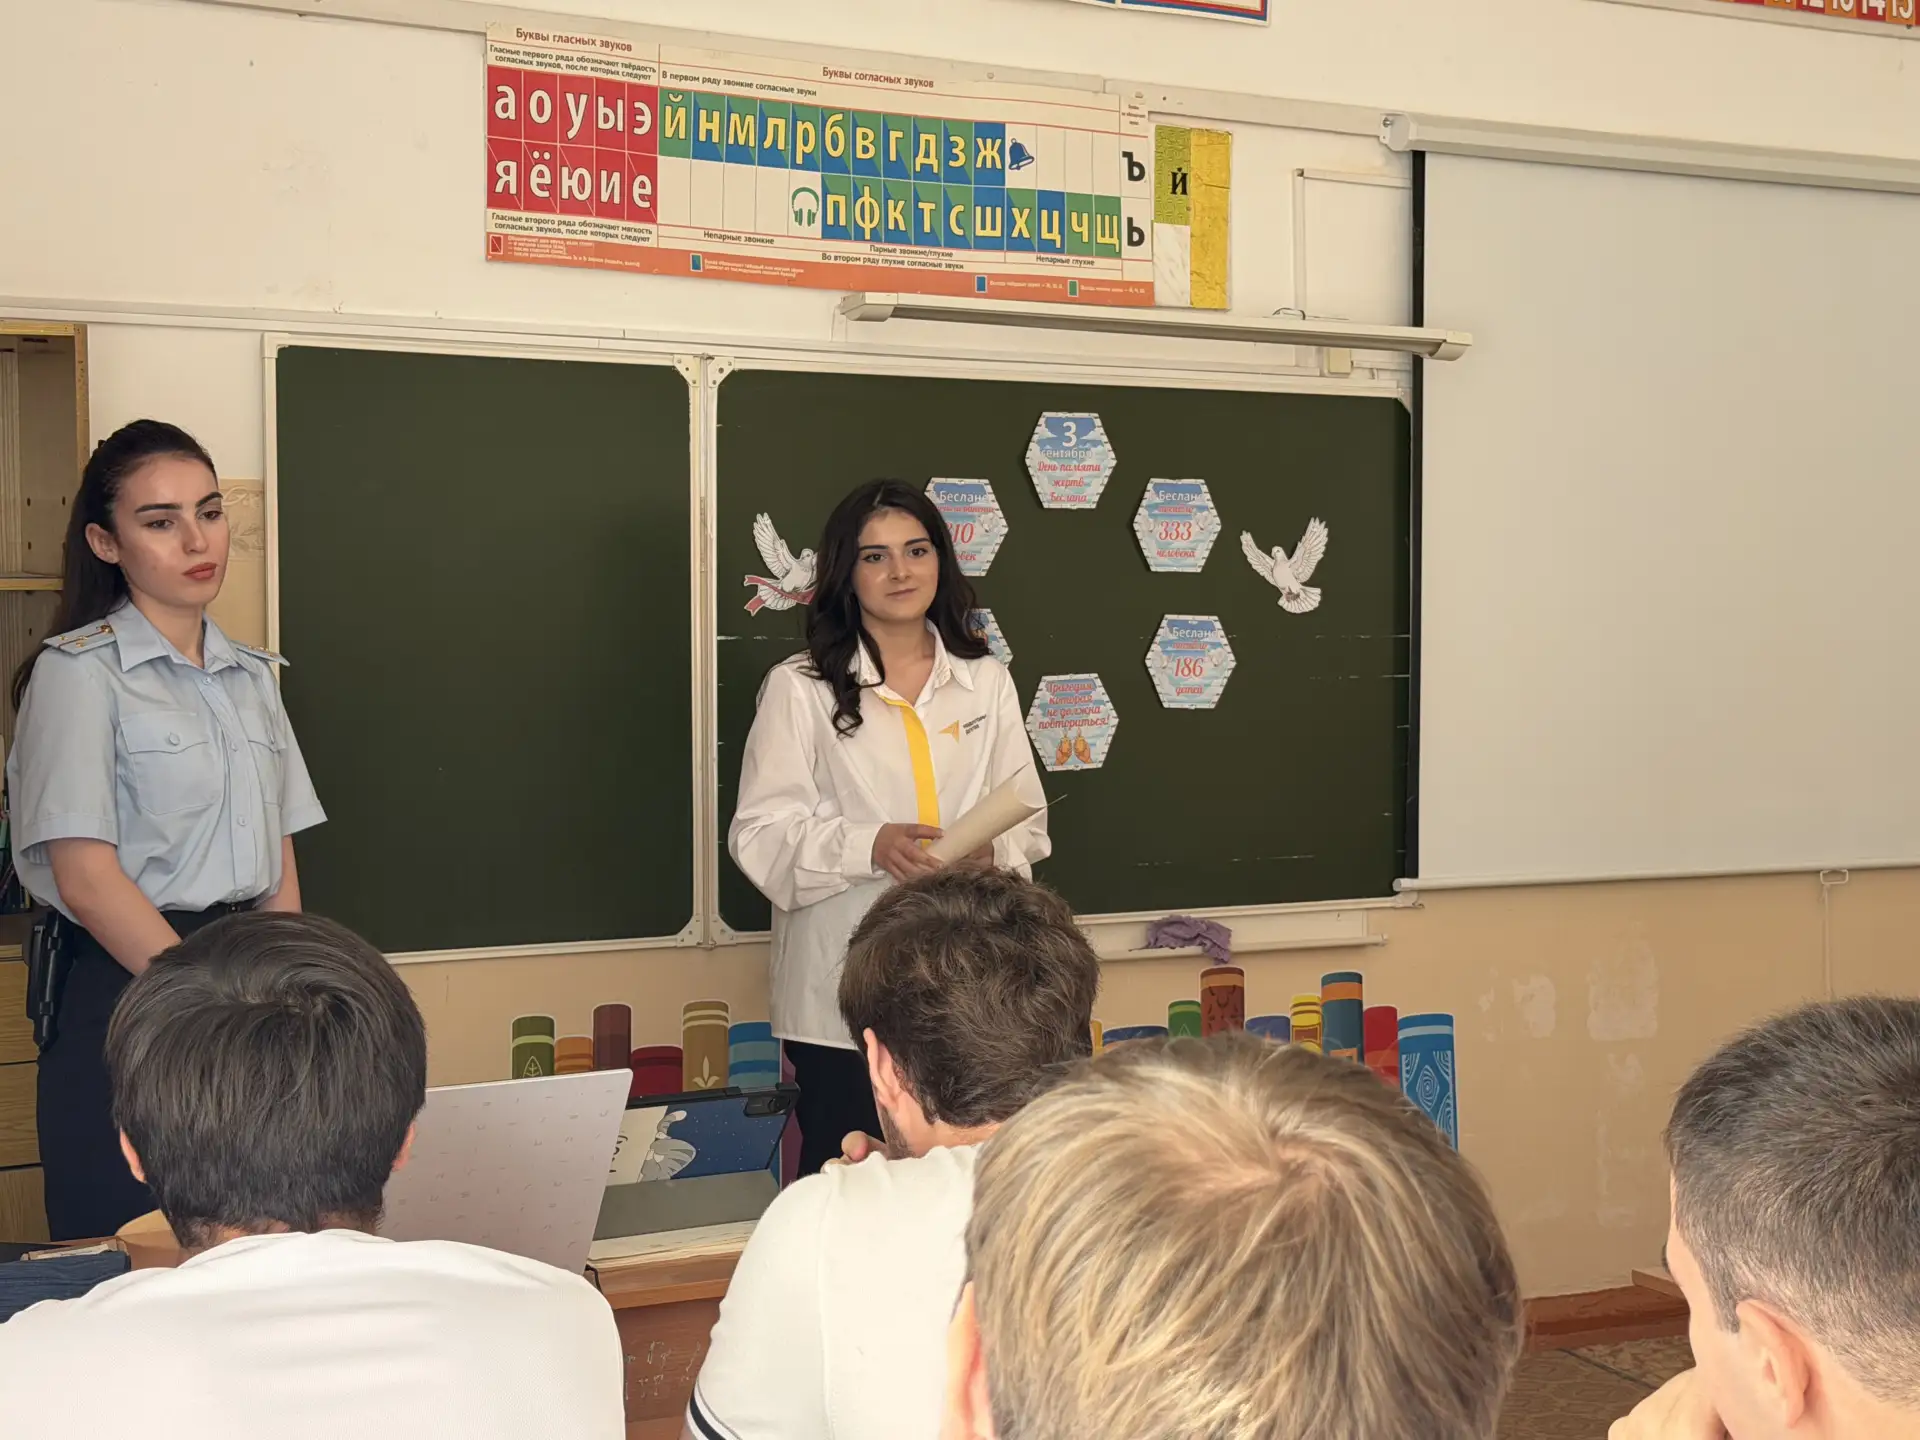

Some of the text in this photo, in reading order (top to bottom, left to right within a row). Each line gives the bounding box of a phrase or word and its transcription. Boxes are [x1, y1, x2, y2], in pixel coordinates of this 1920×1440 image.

[516, 27, 633, 52] Буквы гласных звуков
[490, 44, 657, 73] Гласные первого ряда обозначают твёрдость
[495, 55, 652, 81] согласных звуков, после которых следуют
[661, 70, 817, 97] В первом ряду звонкие согласные звуки
[822, 66, 934, 88] Буквы согласных звуков
[494, 85, 653, 141] а о у ы э
[664, 93, 687, 140] й
[698, 108, 721, 144] н
[728, 113, 755, 148] м
[763, 117, 787, 151] л
[795, 120, 816, 165] р
[824, 112, 845, 158] б
[855, 127, 876, 161] в
[889, 130, 904, 162] г
[915, 133, 939, 174] д
[948, 135, 966, 169] з
[975, 137, 1003, 170] ж
[494, 150, 652, 209] я ё ю и е
[492, 212, 653, 235] Гласные второго ряда обозначают мягкость
[826, 194, 847, 227] п
[854, 185, 880, 241] ф
[887, 199, 907, 232] к
[918, 202, 936, 234] т
[949, 204, 965, 236] с
[975, 206, 1002, 238] ш
[1011, 207, 1031, 239] х
[1040, 209, 1062, 249] ц
[1071, 212, 1089, 244] ч
[1096, 214, 1120, 252] щ
[494, 222, 651, 243] согласных звуков, после которых следуют
[703, 230, 775, 245] Непарные звонкие
[821, 252, 964, 271] Во втором ряду глухие согласные звуки
[869, 244, 954, 259] Парные звонкие/глухие
[1036, 254, 1095, 268] Непарные глухие
[1062, 421, 1077, 447] 3
[1037, 461, 1101, 472] День памяти
[1159, 521, 1193, 541] 333
[1156, 549, 1196, 558] человека
[1174, 657, 1205, 678] 186
[1038, 715, 1110, 730] повториться!
[1047, 706, 1102, 718] не должна
